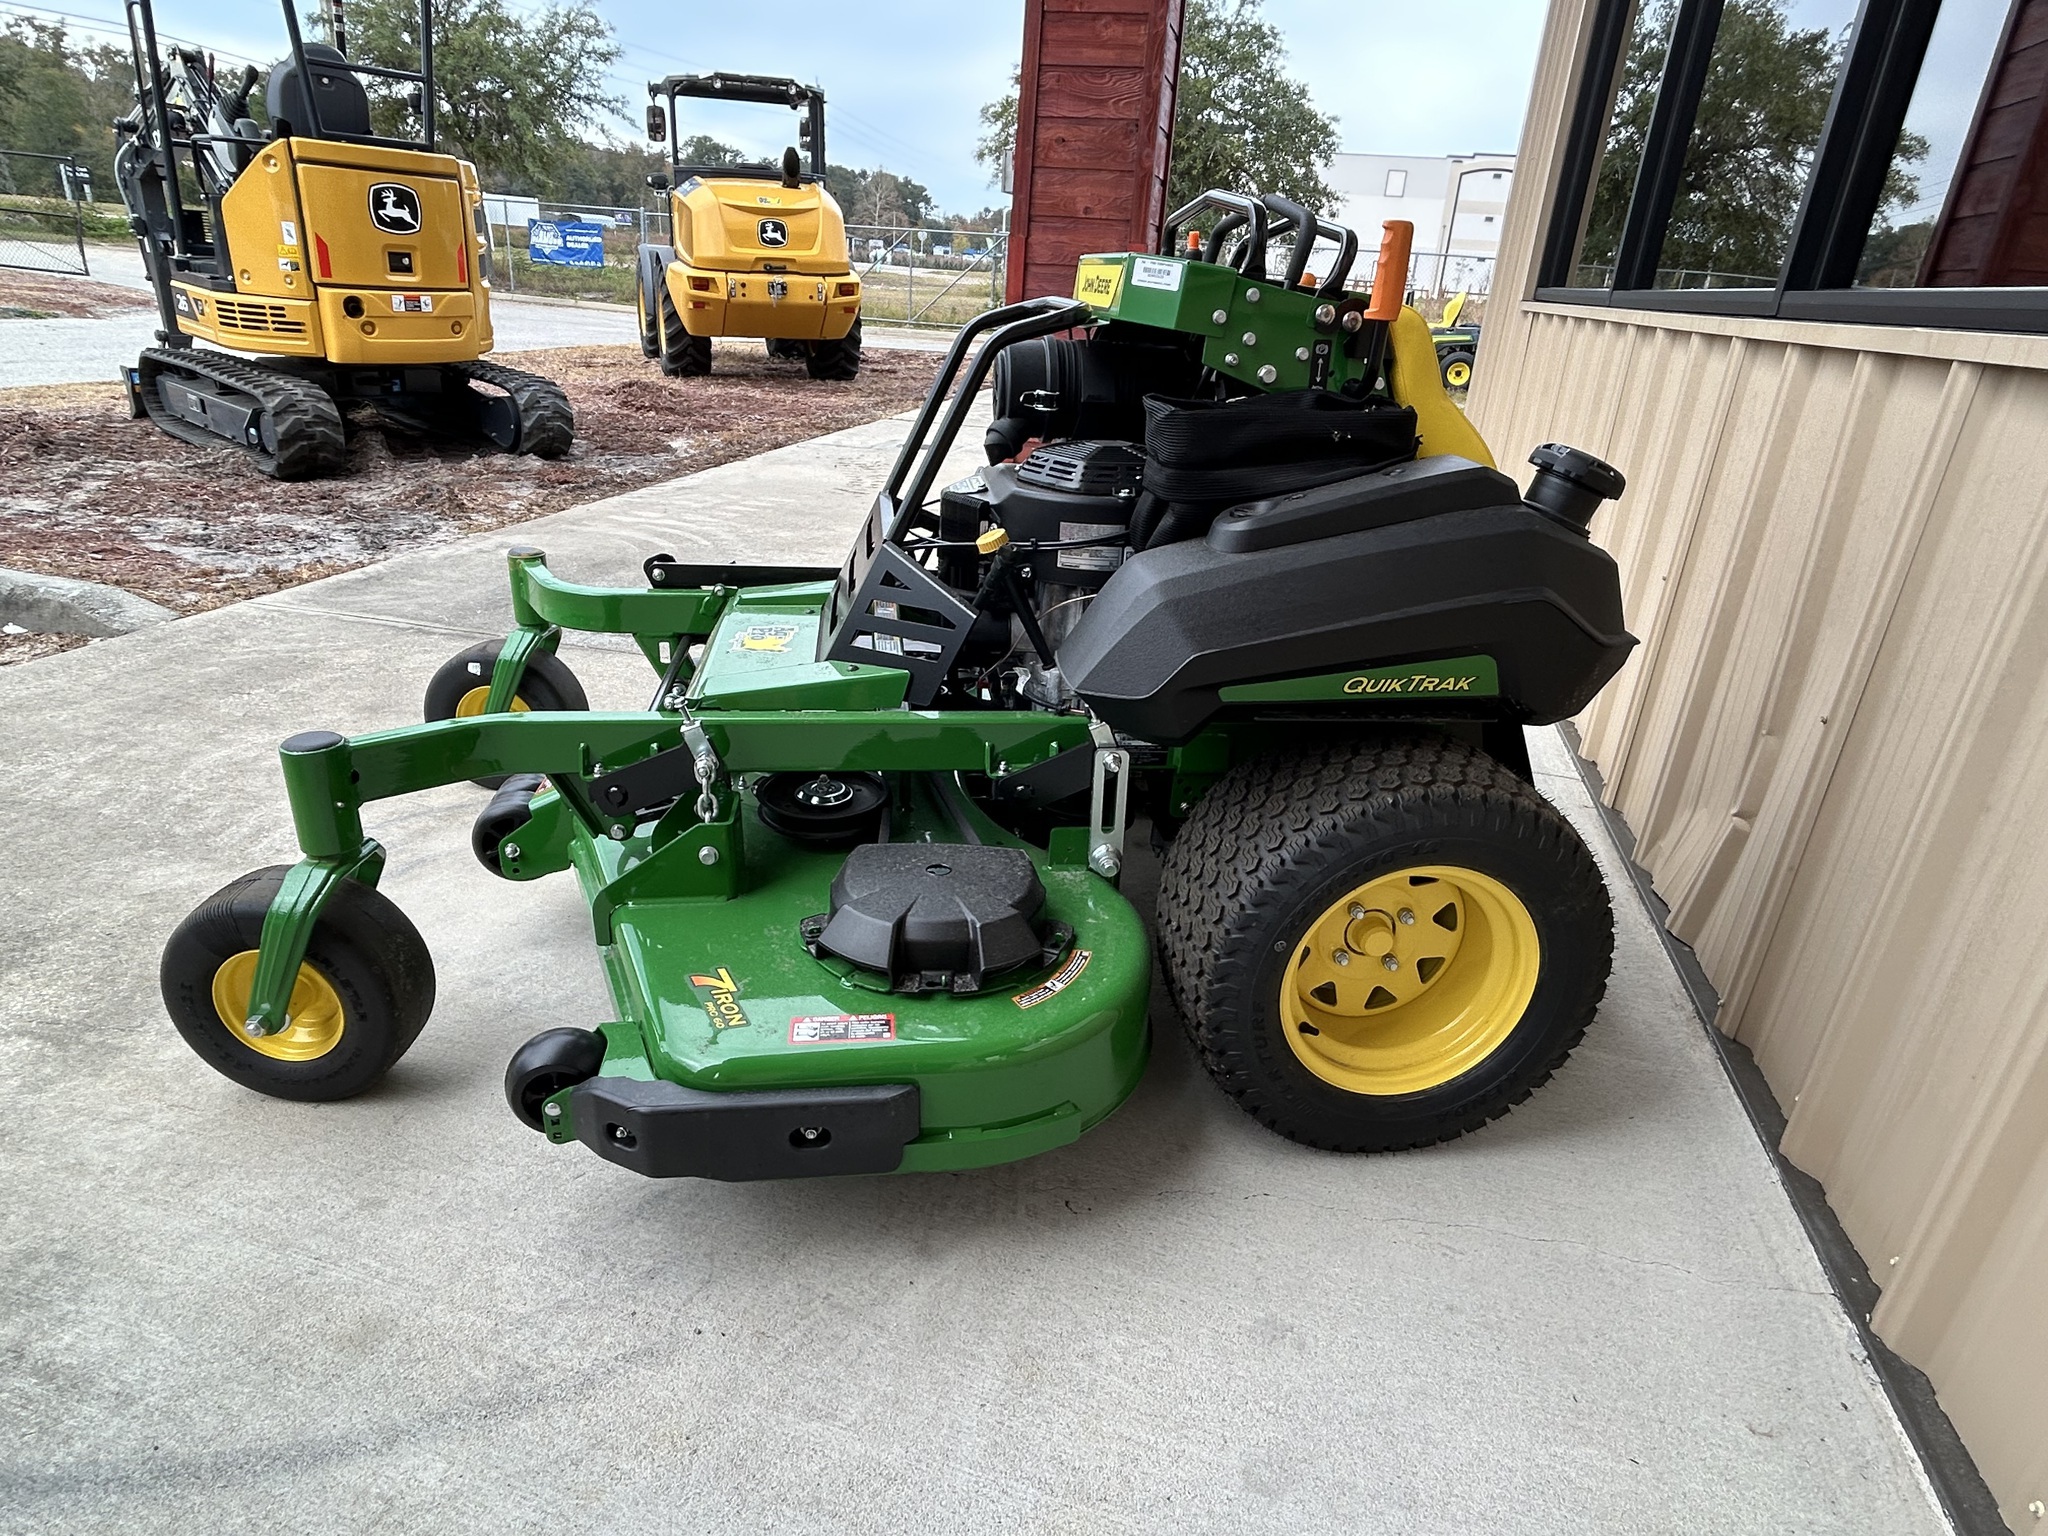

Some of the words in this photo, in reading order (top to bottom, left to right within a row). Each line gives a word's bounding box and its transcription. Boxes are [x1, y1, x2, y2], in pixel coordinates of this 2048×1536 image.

[1082, 274, 1097, 293] JOHN
[1094, 275, 1112, 295] DEERE
[689, 966, 739, 992] 7
[704, 1001, 719, 1017] PRO
[713, 1017, 726, 1029] 60
[710, 988, 748, 1027] IRON
